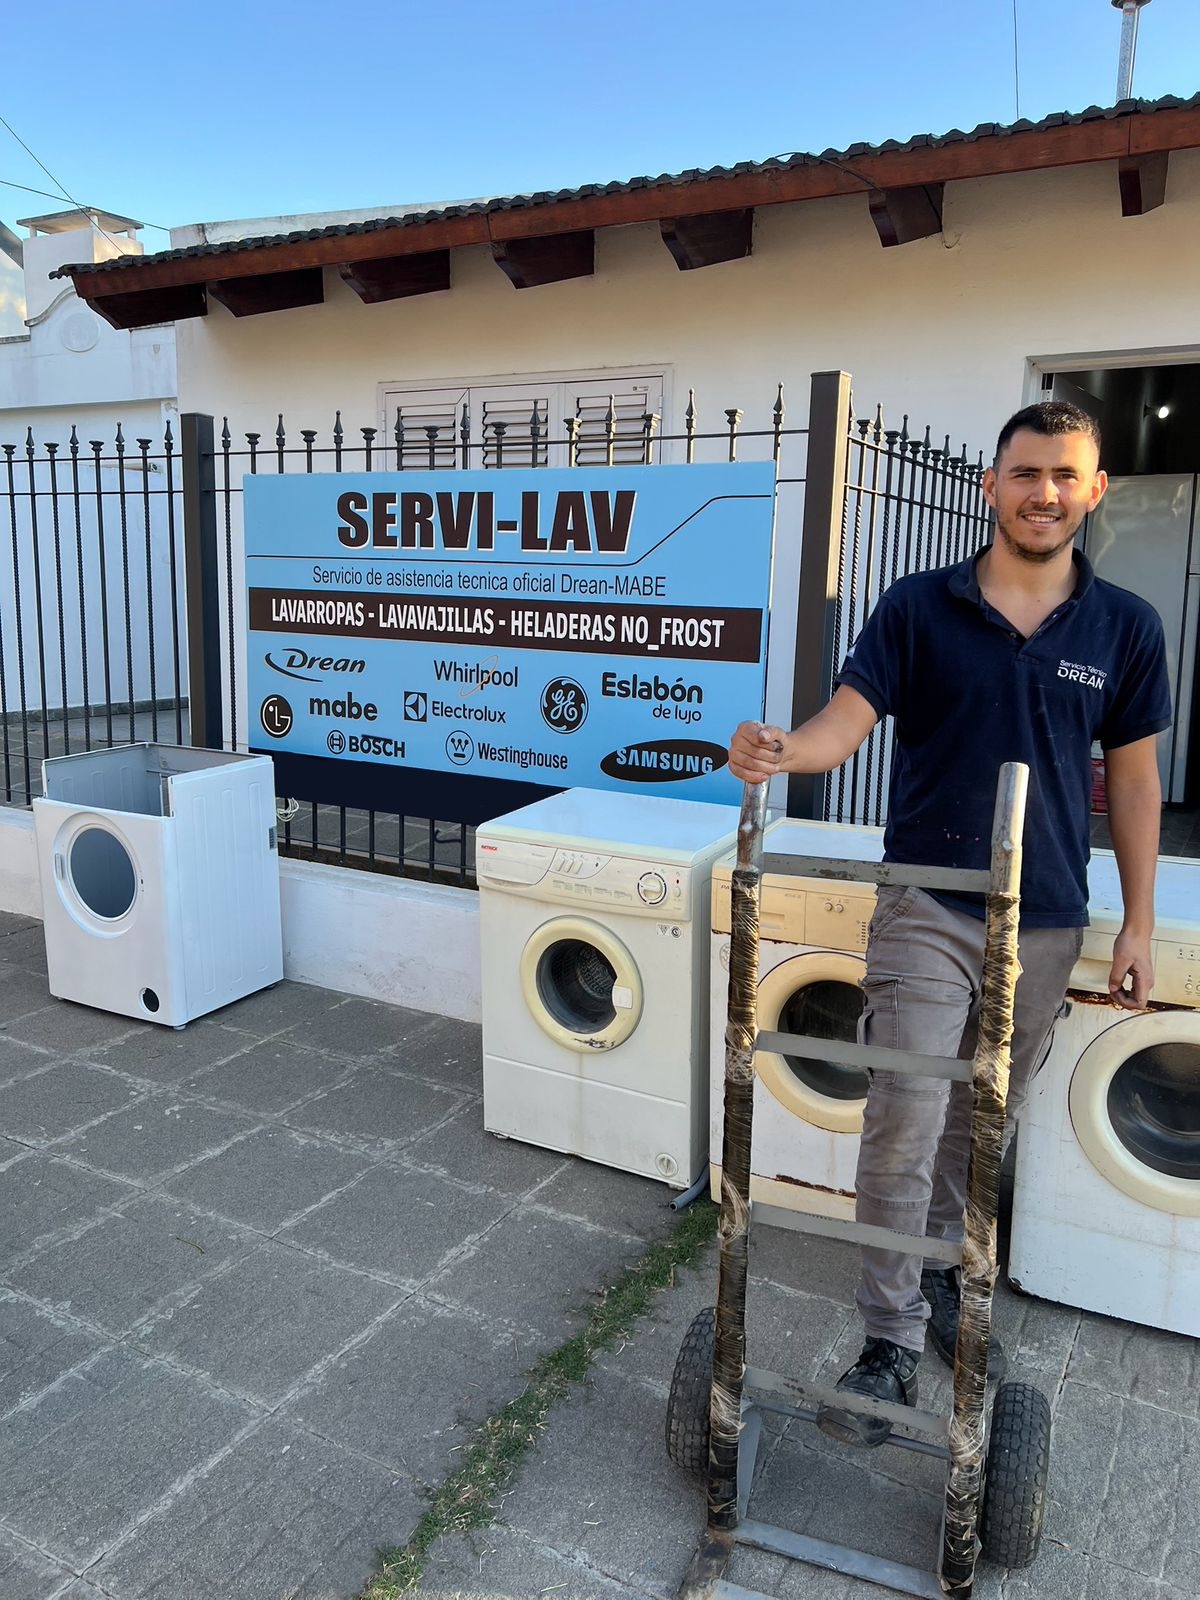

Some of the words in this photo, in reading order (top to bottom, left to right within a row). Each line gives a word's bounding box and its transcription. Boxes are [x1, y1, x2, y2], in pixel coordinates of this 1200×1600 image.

[336, 491, 638, 554] SERVI-LAV
[312, 565, 363, 585] Servicio
[366, 567, 382, 585] de
[386, 569, 453, 589] asistencia
[457, 570, 508, 591] tecnica
[512, 572, 556, 593] oficial
[561, 574, 667, 597] Drean-MABE
[272, 598, 365, 627] LAVARROPAS
[379, 603, 495, 635] LAVAVAJILLAS
[510, 610, 616, 643] HELADERAS
[282, 648, 366, 674] Drean
[433, 659, 519, 690] Whirlpool
[1060, 659, 1086, 671] Servicio
[601, 671, 703, 703] Eslabón
[1057, 666, 1105, 690] DREAN
[264, 697, 292, 736] LG
[309, 692, 378, 721] mabe
[432, 701, 506, 724] Electrolux
[652, 704, 671, 719] de
[674, 705, 702, 724] lujo
[348, 734, 406, 758] BOSCH
[477, 742, 568, 769] Westinghouse
[616, 749, 715, 774] SAMSUNG
